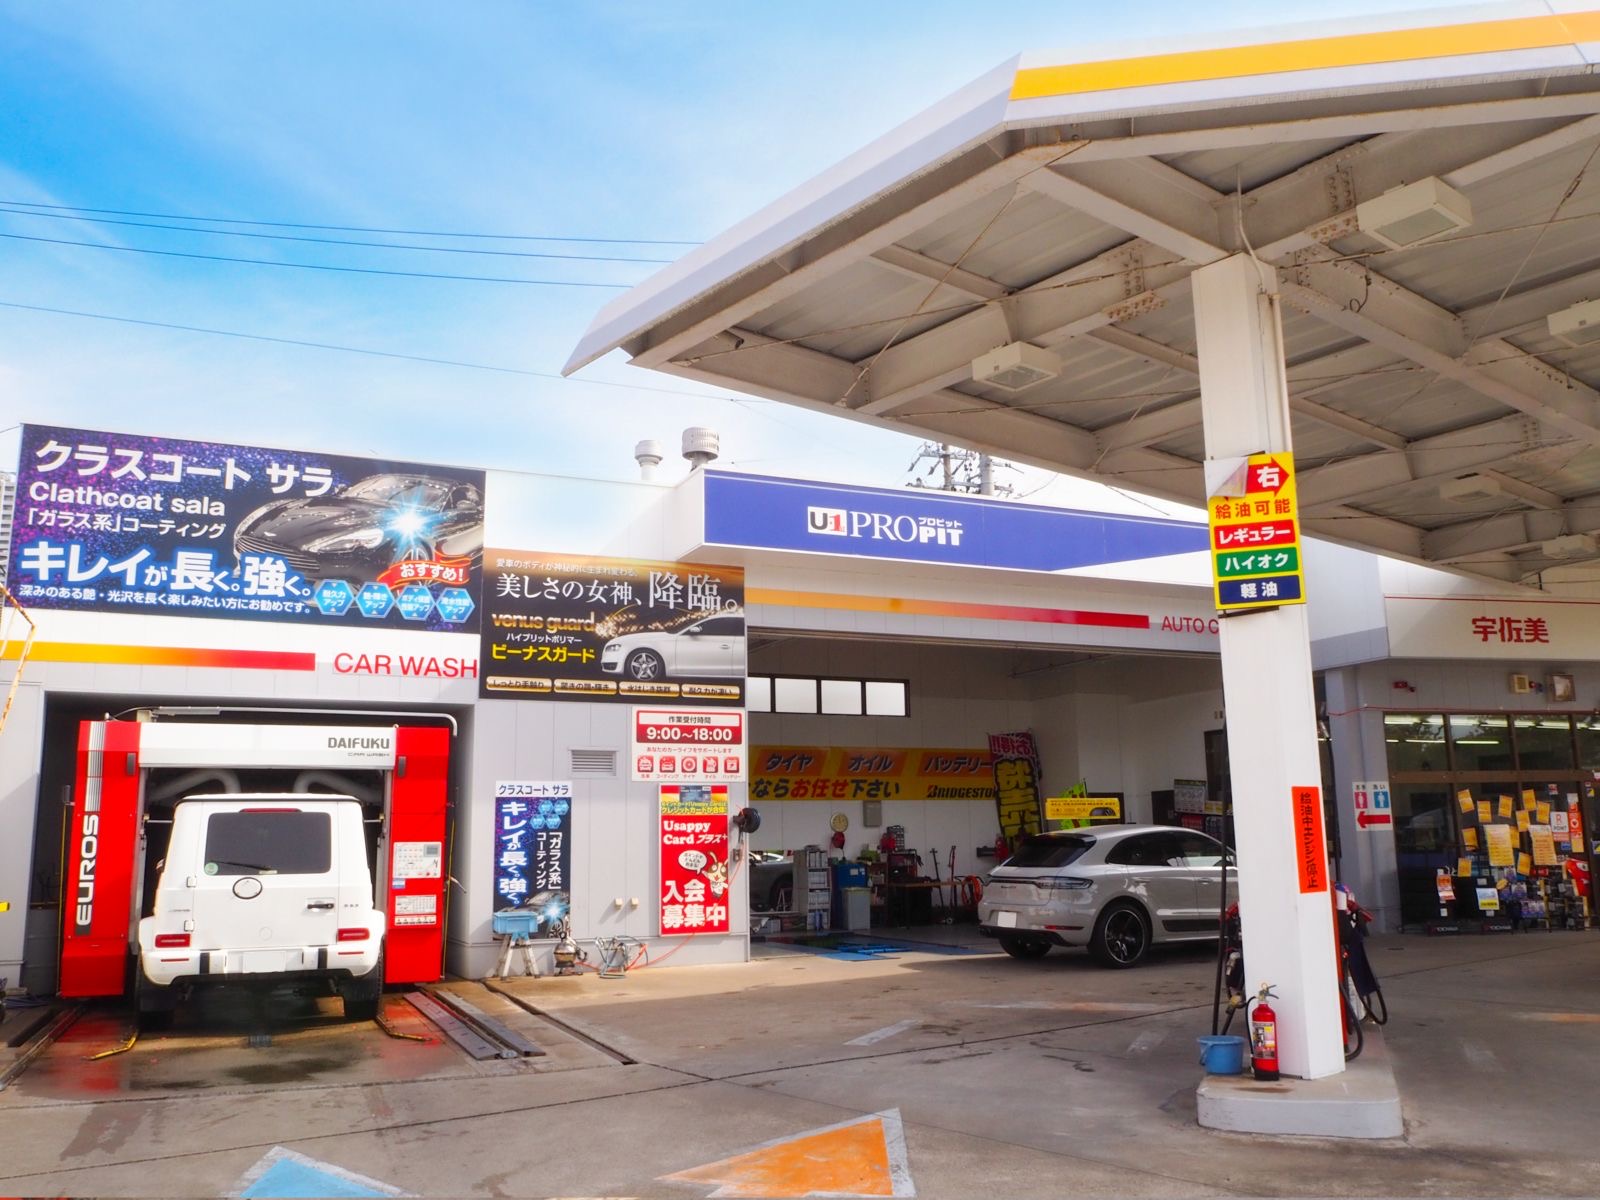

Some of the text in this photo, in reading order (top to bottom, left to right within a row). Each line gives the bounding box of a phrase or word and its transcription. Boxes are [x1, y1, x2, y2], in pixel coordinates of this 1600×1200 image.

[35, 440, 333, 498] クラスコート サラ
[1256, 466, 1280, 488] 右
[28, 481, 226, 518] Clathcoat sala
[1215, 498, 1291, 519] 給油可能
[28, 507, 227, 540] 「ガラス系」コーティング
[849, 511, 918, 542] PRO
[918, 516, 963, 528] プロピット
[919, 526, 964, 546] PIT
[1219, 526, 1291, 545] レギュラー
[20, 540, 312, 598] キレイが長く。強く。
[1225, 553, 1289, 571] ハイオク
[496, 570, 738, 611] 美しさの女神、降臨。
[1240, 582, 1279, 598] 軽油
[323, 598, 345, 607] アップ
[491, 612, 596, 634] venus guard
[1161, 615, 1205, 634] AUTO
[1471, 616, 1550, 643] 宇佐美
[491, 643, 596, 664] ビーナスガード
[334, 652, 478, 679] CAR WASH
[328, 737, 390, 750] DAIFUKU
[765, 753, 993, 774] タイヤ オイル バッテリー
[499, 784, 569, 796] クラスコート サラ
[663, 820, 711, 833] Usappy
[663, 834, 695, 845] Card
[1300, 792, 1319, 889] 給油中エンジン停止
[499, 801, 527, 905] キレイが長く。強く。
[536, 832, 546, 889] コーティング
[76, 813, 99, 926] EUROS
[662, 879, 706, 903] 入会
[662, 904, 727, 929] 募集中
